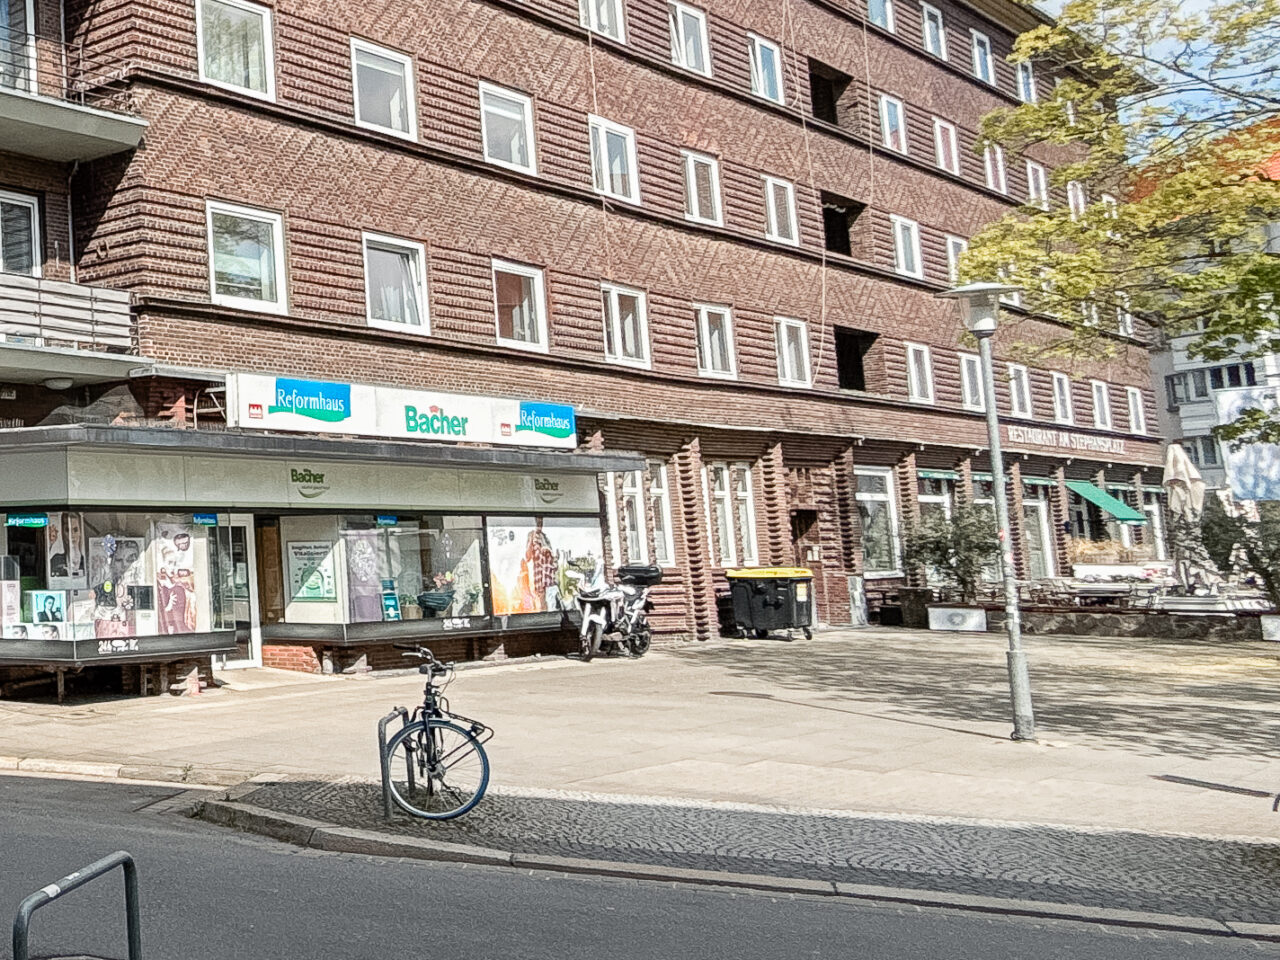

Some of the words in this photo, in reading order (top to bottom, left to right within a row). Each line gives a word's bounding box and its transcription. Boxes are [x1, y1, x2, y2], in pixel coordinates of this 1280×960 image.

[277, 389, 345, 414] Reformhaus
[405, 405, 469, 435] Bacher
[521, 410, 571, 432] Reformhaus
[1007, 426, 1057, 445] RESTAURANT
[291, 468, 325, 483] Bacher
[534, 478, 559, 491] Bacher
